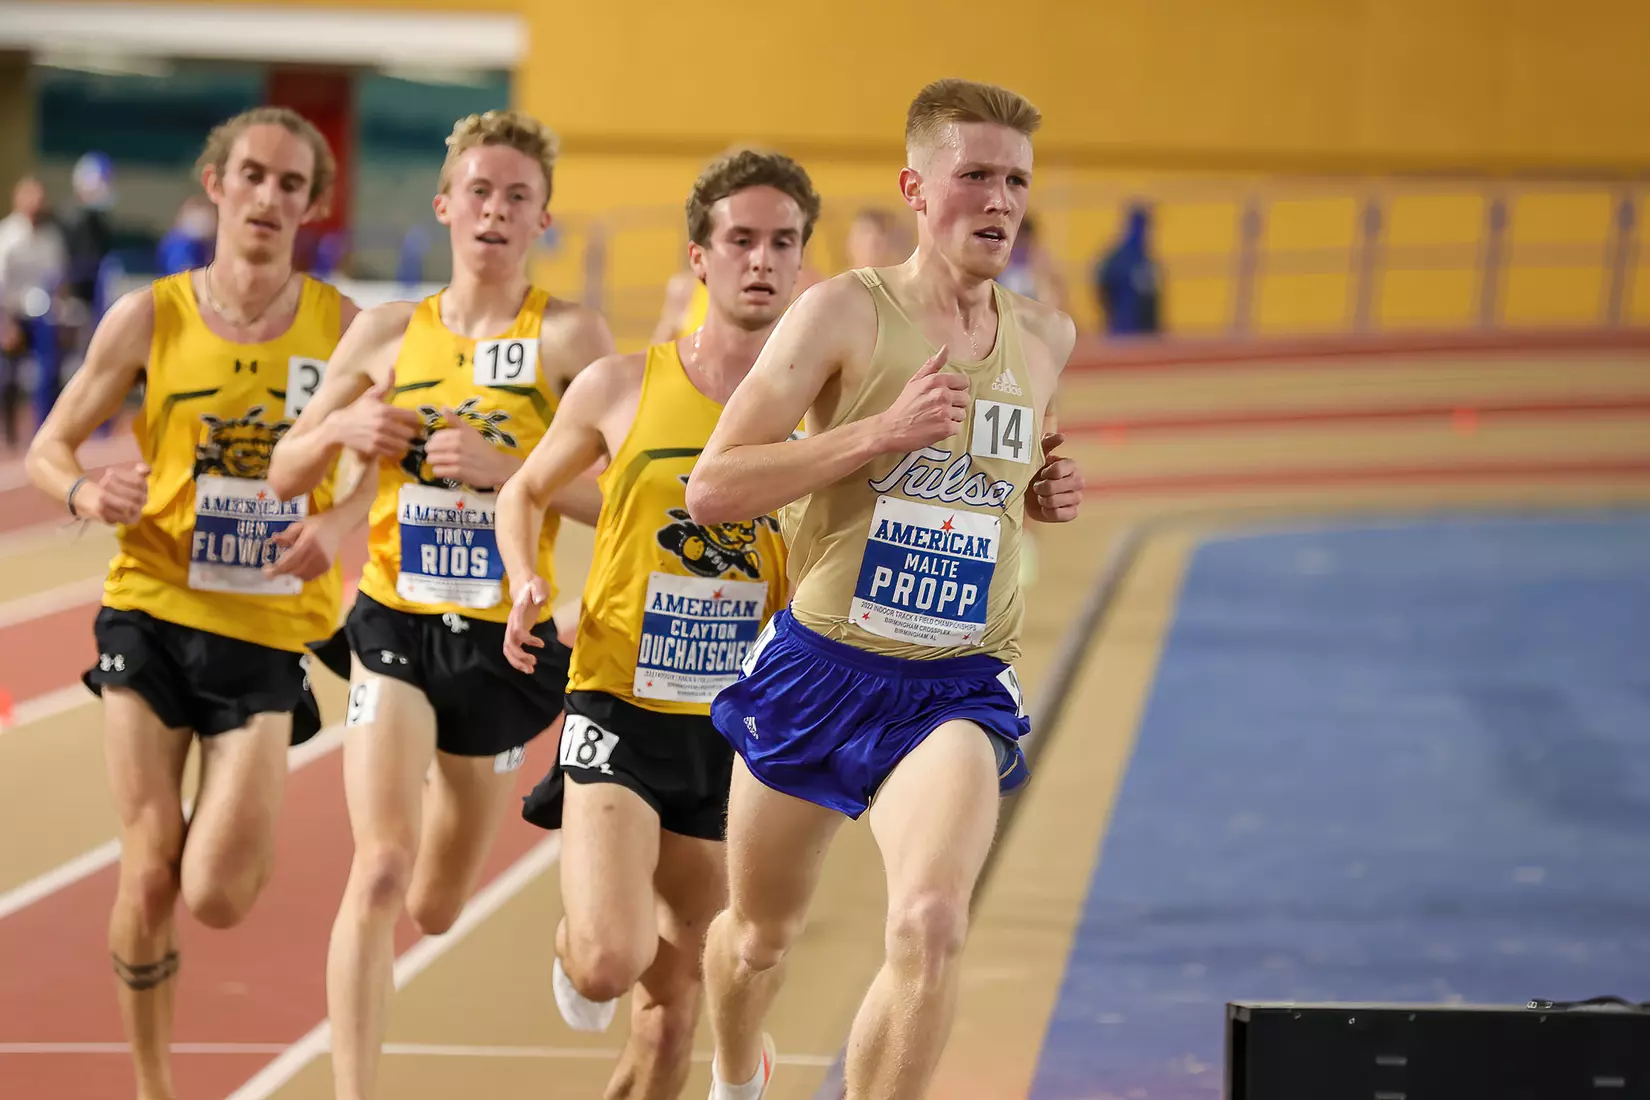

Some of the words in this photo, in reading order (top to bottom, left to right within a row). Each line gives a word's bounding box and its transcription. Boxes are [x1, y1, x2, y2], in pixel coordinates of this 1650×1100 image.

[486, 342, 524, 380] 19
[991, 382, 1023, 397] adidas
[984, 405, 1023, 459] 14
[868, 446, 1014, 510] Tulsa
[874, 518, 992, 560] AMERICAN
[420, 543, 489, 578] RIOS
[903, 552, 961, 579] MALTE
[651, 591, 758, 618] AMERICAN
[868, 565, 979, 617] PROPP
[670, 619, 738, 640] CLAYTON
[873, 604, 895, 617] INDOOR
[895, 610, 914, 621] TRACK
[918, 615, 934, 625] FIELD
[884, 616, 919, 631] BIRMINGHAM
[919, 624, 952, 636] CROSSPLEX
[565, 723, 605, 766] 18
